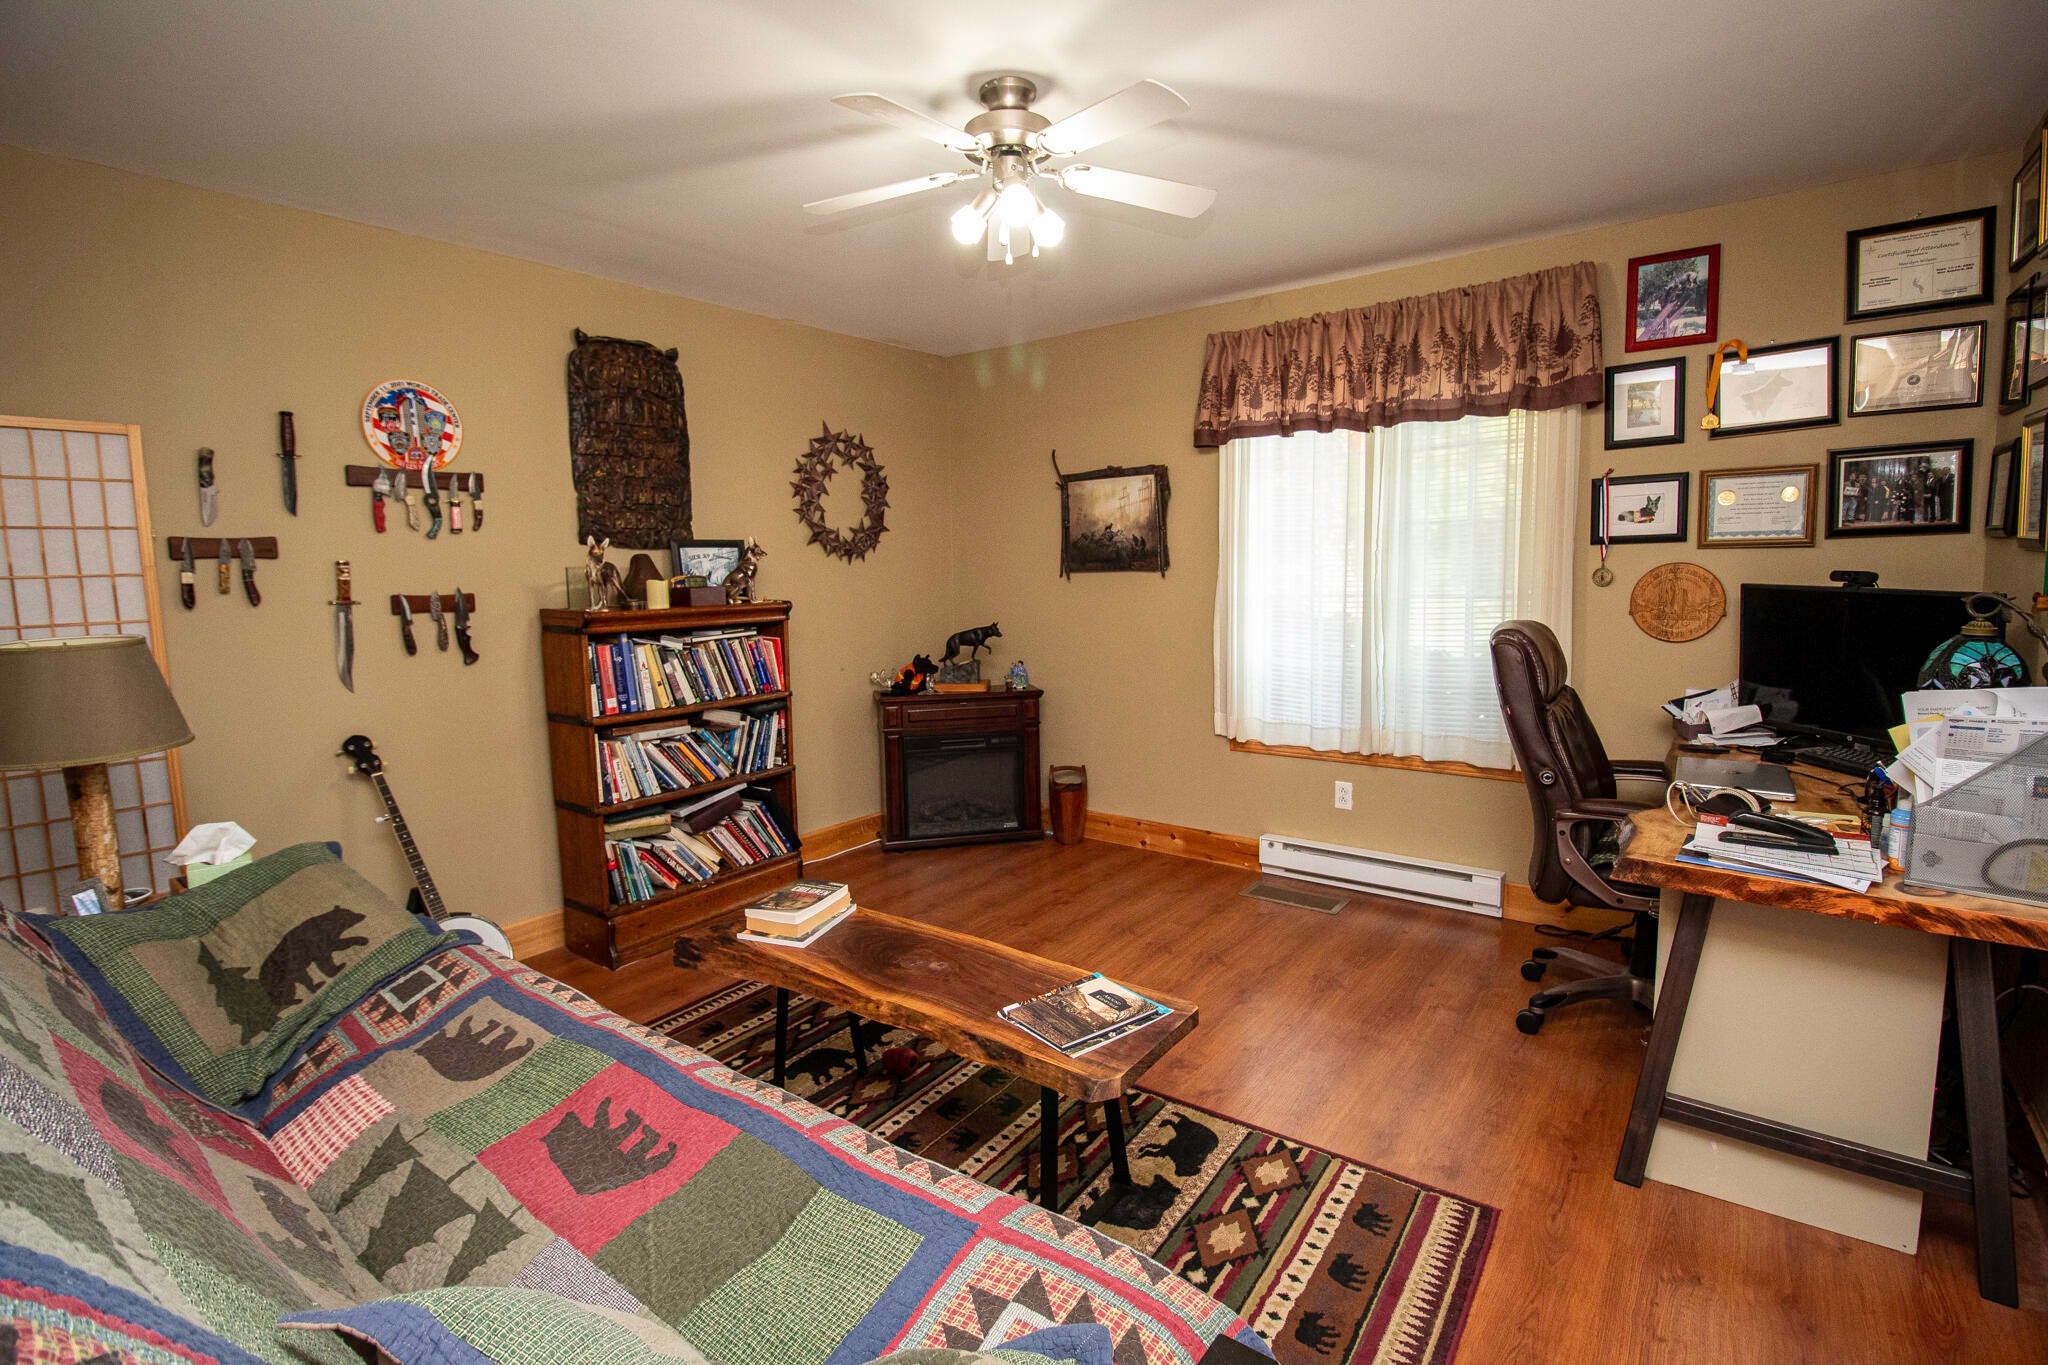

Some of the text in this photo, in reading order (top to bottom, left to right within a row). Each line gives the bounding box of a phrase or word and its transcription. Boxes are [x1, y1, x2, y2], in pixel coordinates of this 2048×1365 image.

[365, 390, 381, 422] SEPTEMBER
[406, 381, 430, 392] WORLD
[431, 387, 449, 405] TRADE
